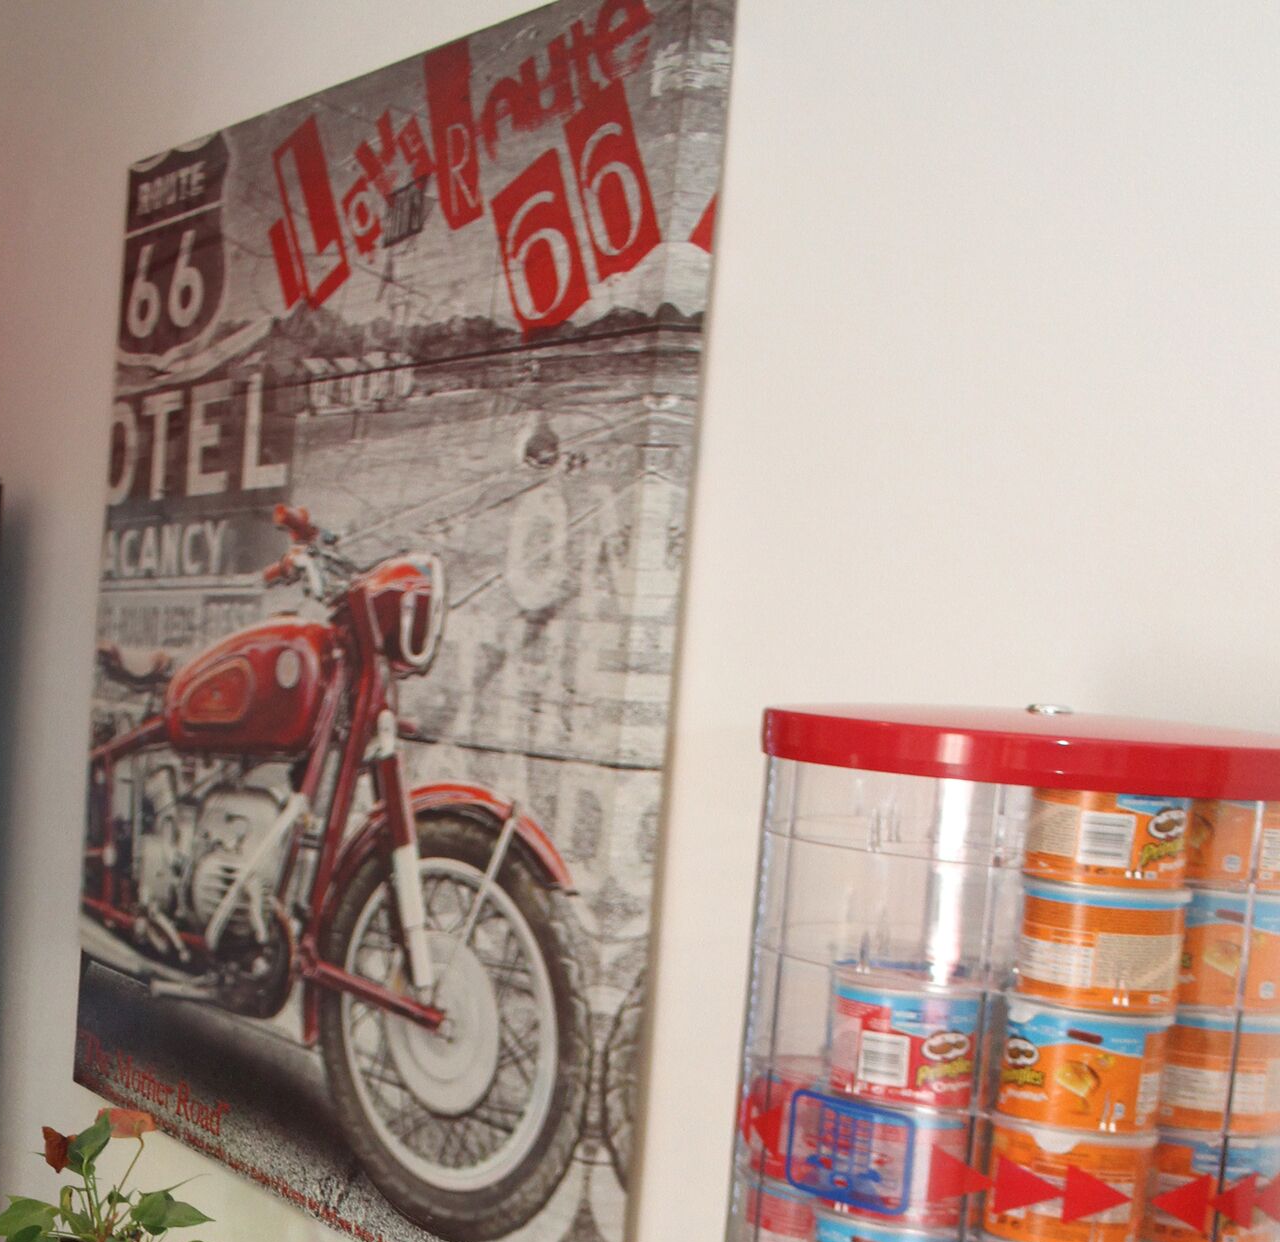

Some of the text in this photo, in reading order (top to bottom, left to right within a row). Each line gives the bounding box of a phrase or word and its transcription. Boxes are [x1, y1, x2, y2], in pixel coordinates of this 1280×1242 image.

[136, 160, 207, 216] ROUTE
[496, 108, 654, 332] 66
[126, 229, 205, 338] 66
[78, 1029, 231, 1137] The Mother Road
